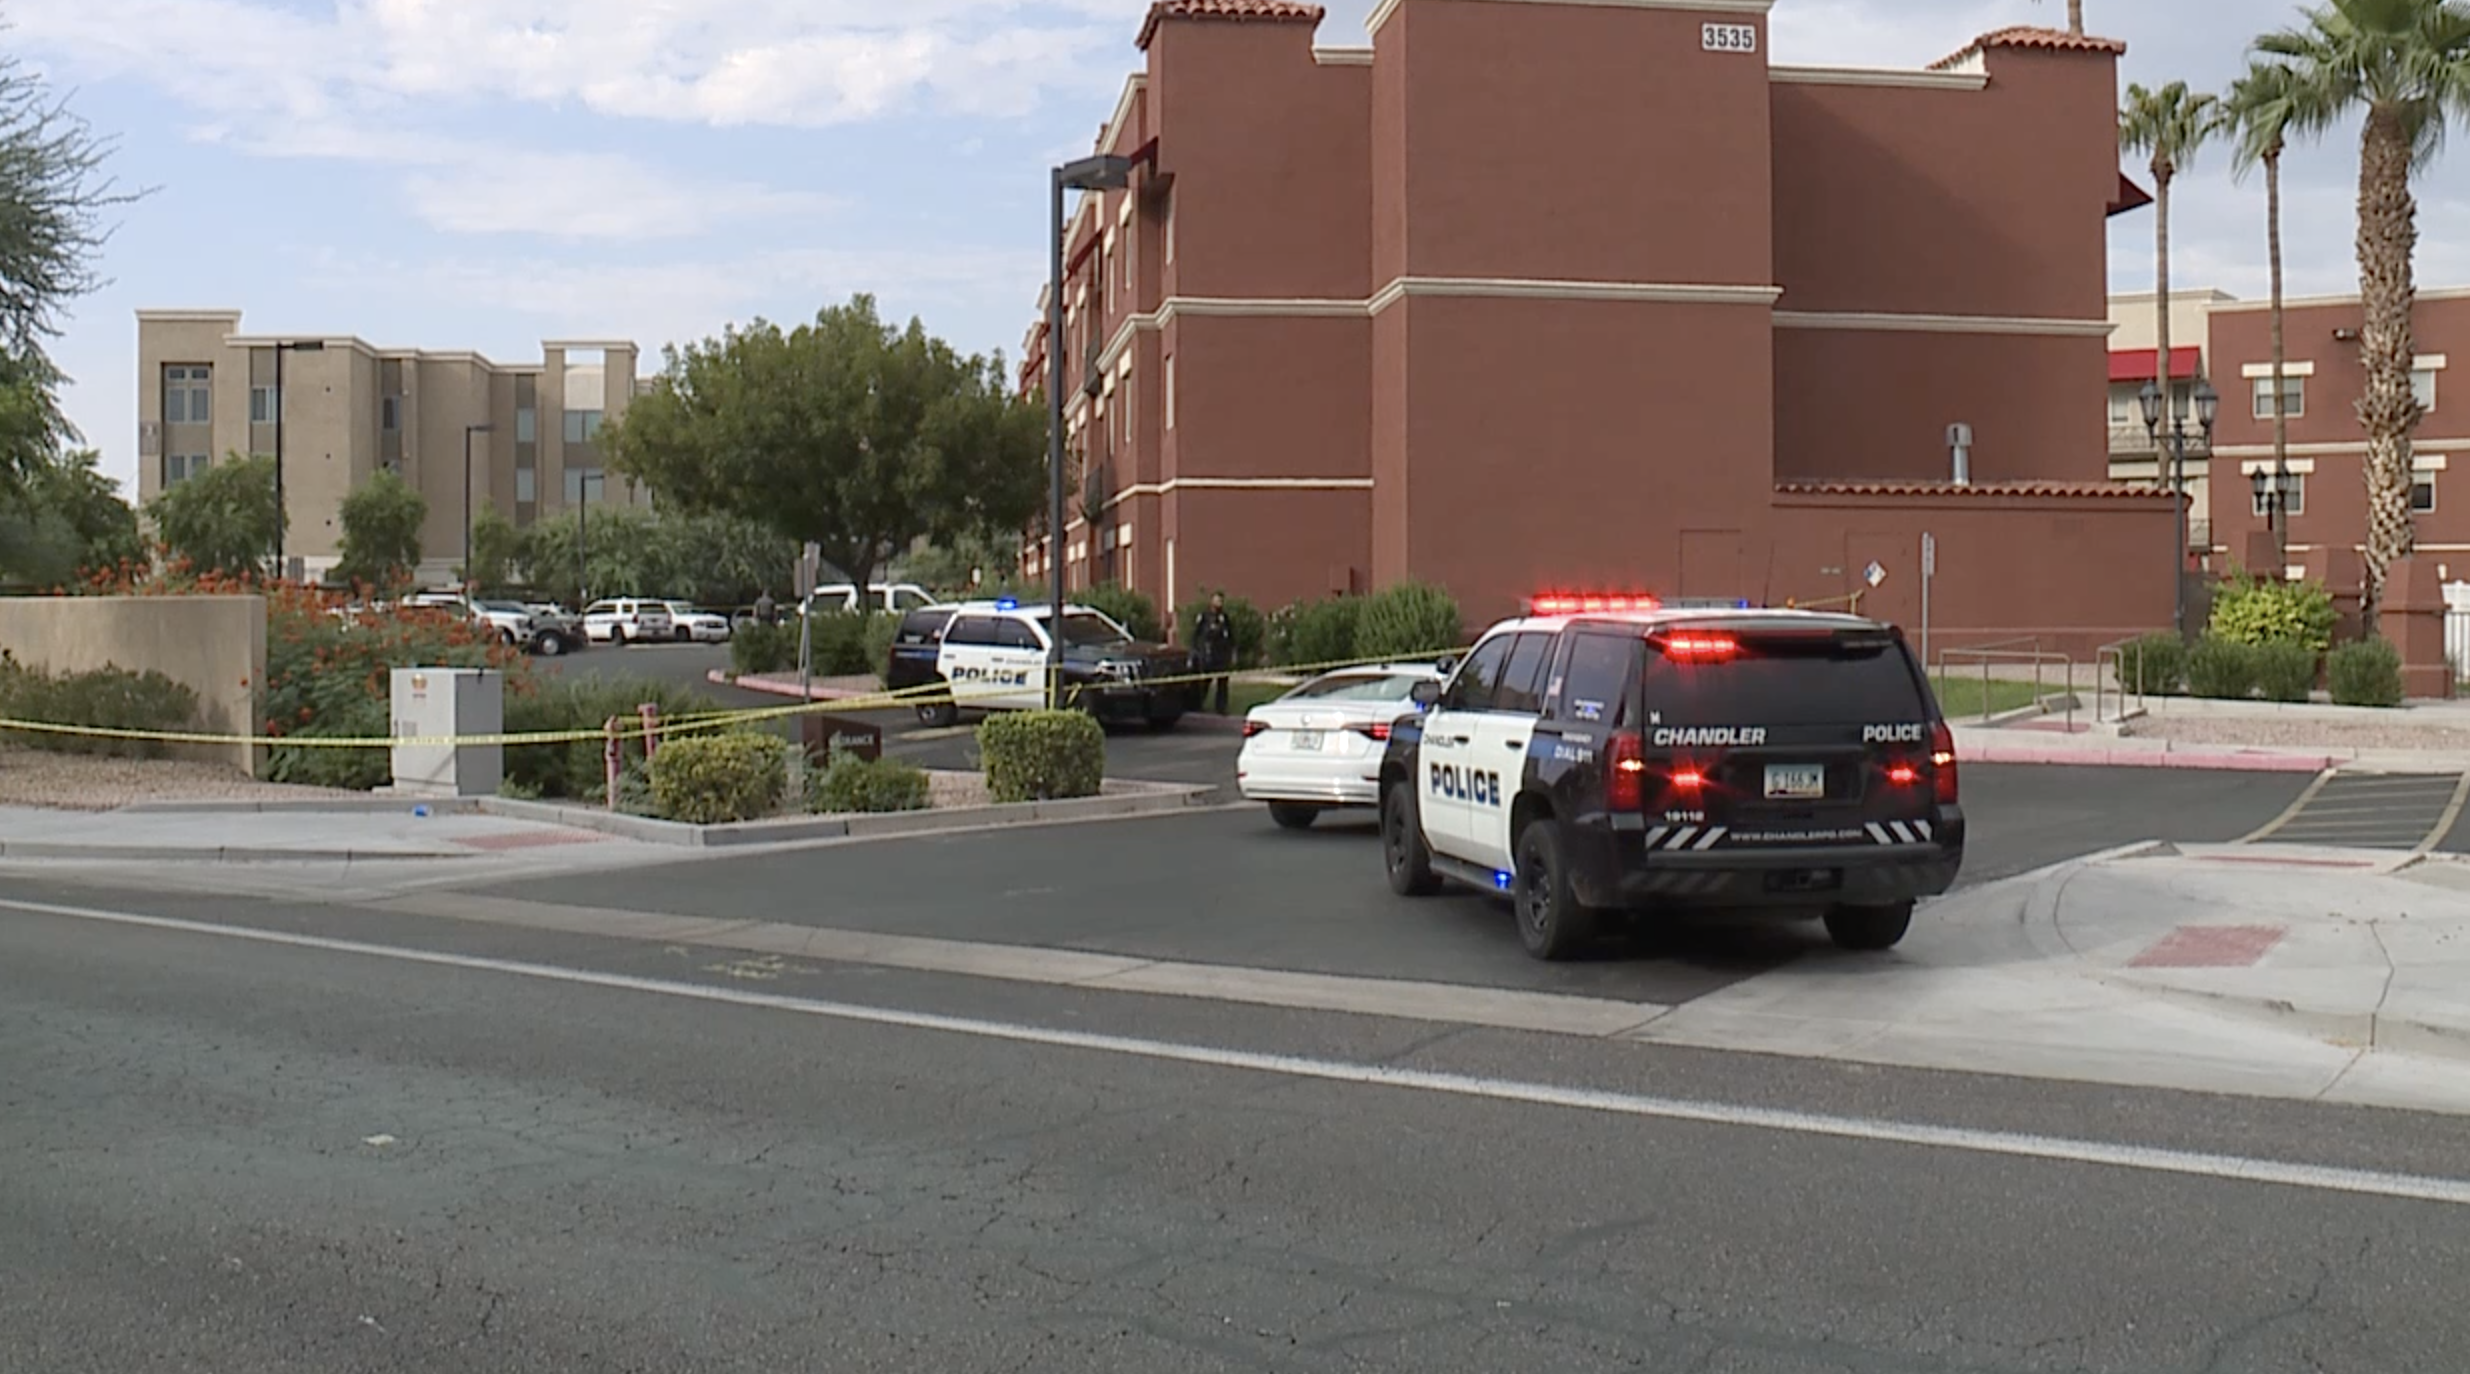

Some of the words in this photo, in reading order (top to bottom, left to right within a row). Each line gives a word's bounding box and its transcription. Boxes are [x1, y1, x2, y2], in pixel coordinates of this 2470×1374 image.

[1704, 27, 1753, 48] 3535
[952, 667, 1027, 685] POLICE
[1653, 727, 1766, 746] CHANDLER
[1863, 724, 1922, 742] POLICE
[1554, 745, 1575, 761] DIAL
[1430, 763, 1500, 807] POLICE
